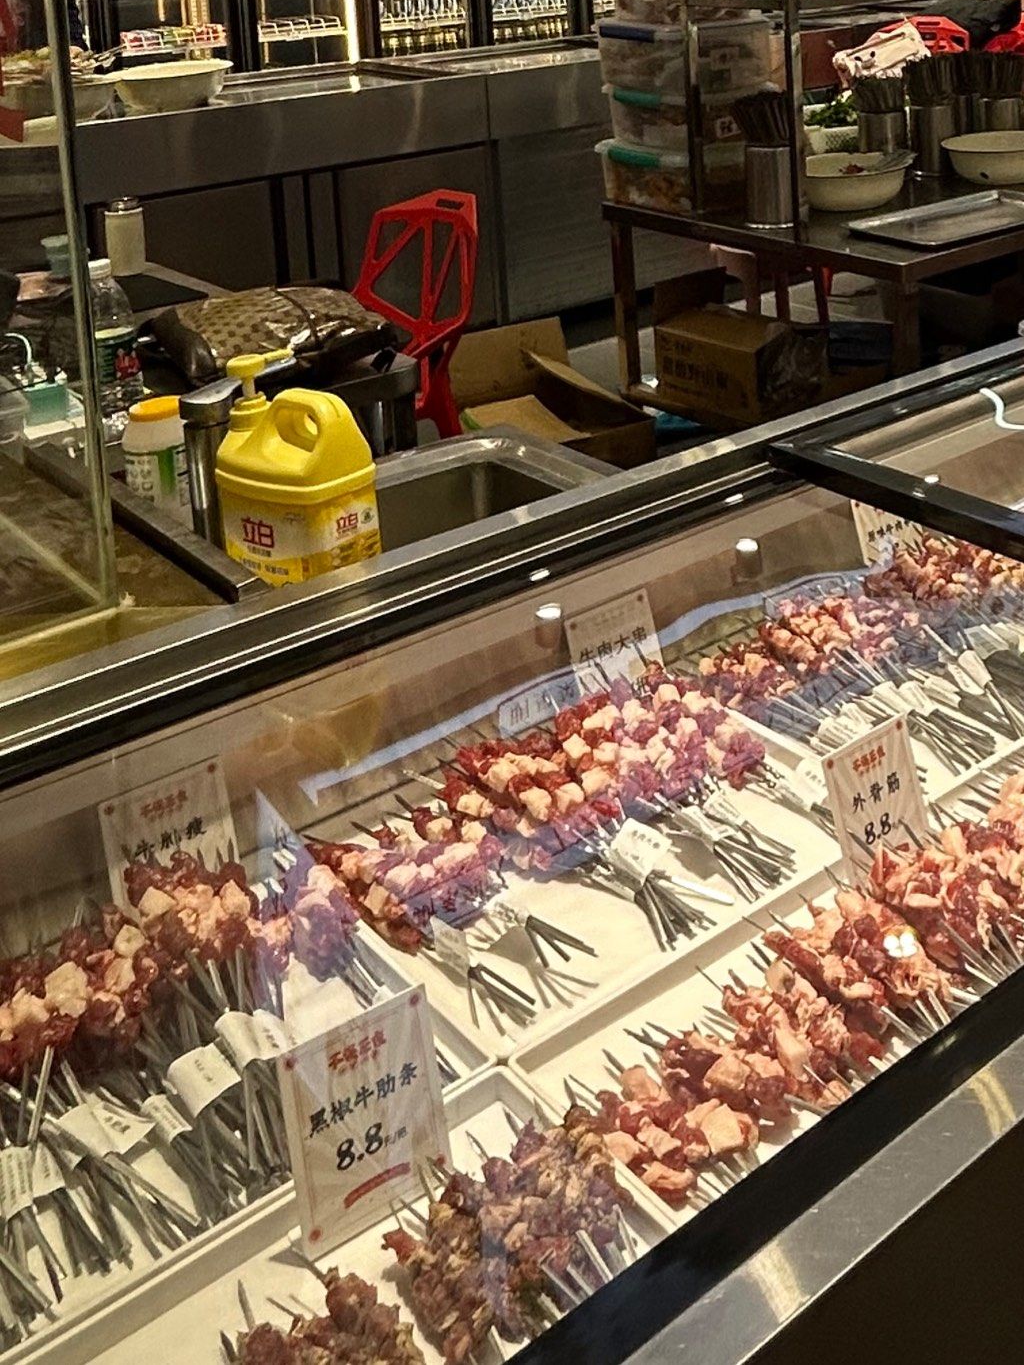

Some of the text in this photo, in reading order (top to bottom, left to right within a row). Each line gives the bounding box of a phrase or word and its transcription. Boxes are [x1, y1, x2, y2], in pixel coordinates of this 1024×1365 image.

[864, 812, 892, 845] 8.8
[309, 1062, 418, 1138] 黑椒牛肋条
[336, 1122, 384, 1171] 8.8
